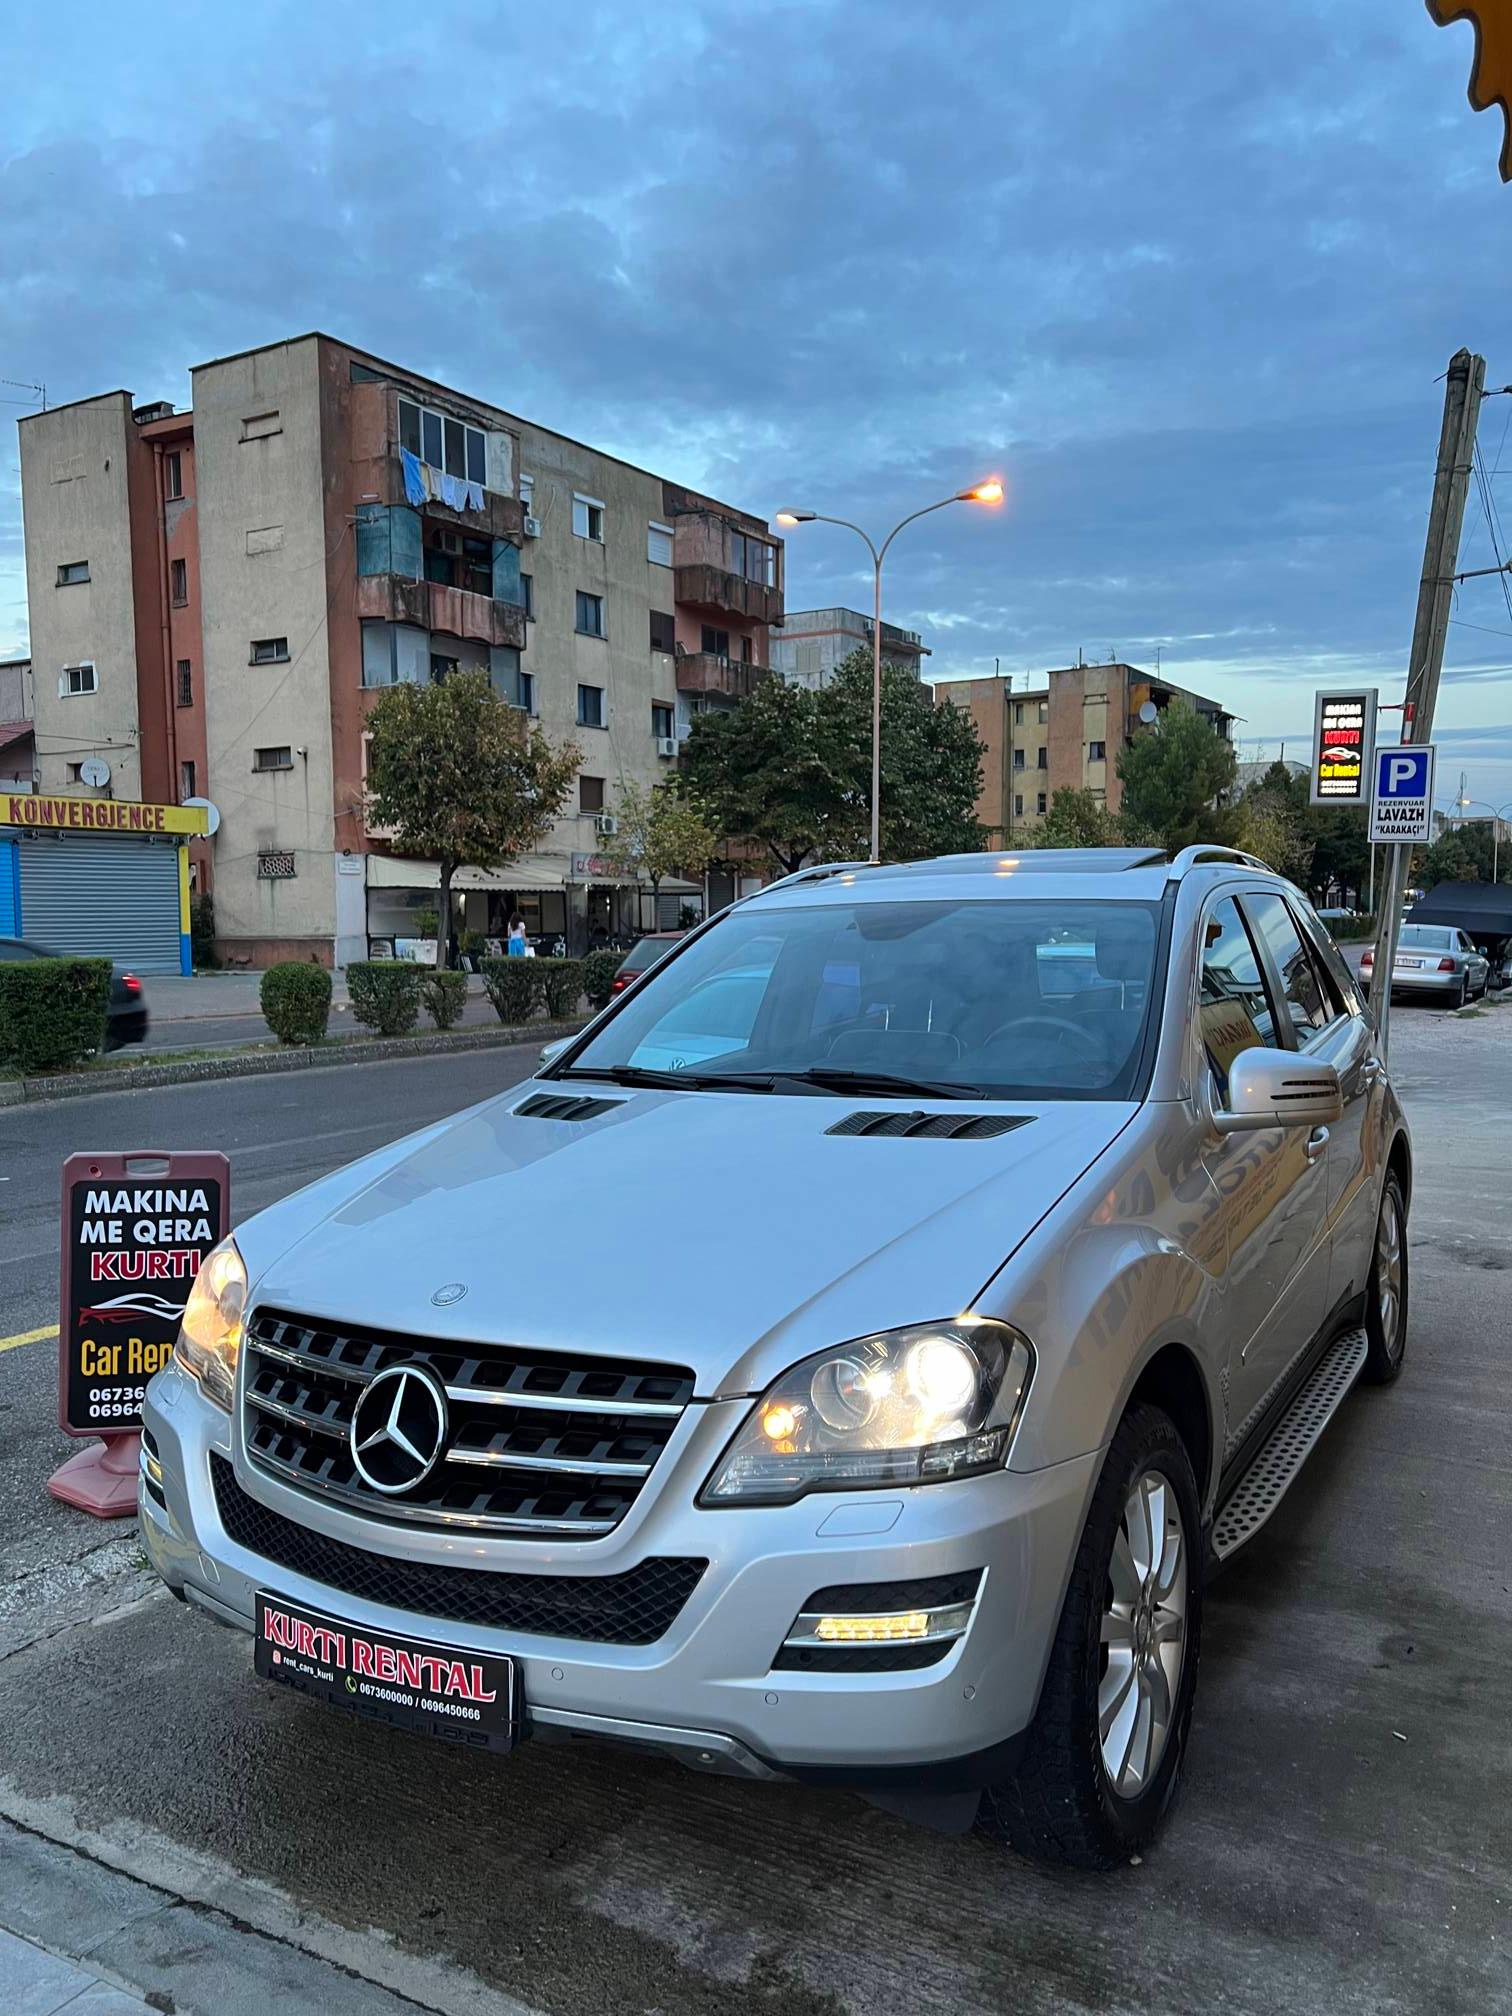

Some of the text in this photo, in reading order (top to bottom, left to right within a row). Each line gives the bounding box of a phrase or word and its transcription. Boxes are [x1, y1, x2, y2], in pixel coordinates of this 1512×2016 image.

[1388, 758, 1417, 793] P
[9, 797, 165, 831] KONVERGJENCE
[1377, 808, 1425, 821] LAVAZH
[84, 1188, 210, 1214] MAKINA
[79, 1218, 213, 1245] ME QERA
[90, 1248, 201, 1281] KURTI
[80, 1338, 122, 1377] Car
[263, 1606, 498, 1703] KURTI RENTAL
[283, 1656, 334, 1682] rent_cars_kurti
[359, 1682, 413, 1706] 0673600000
[420, 1698, 481, 1721] 0696450666
